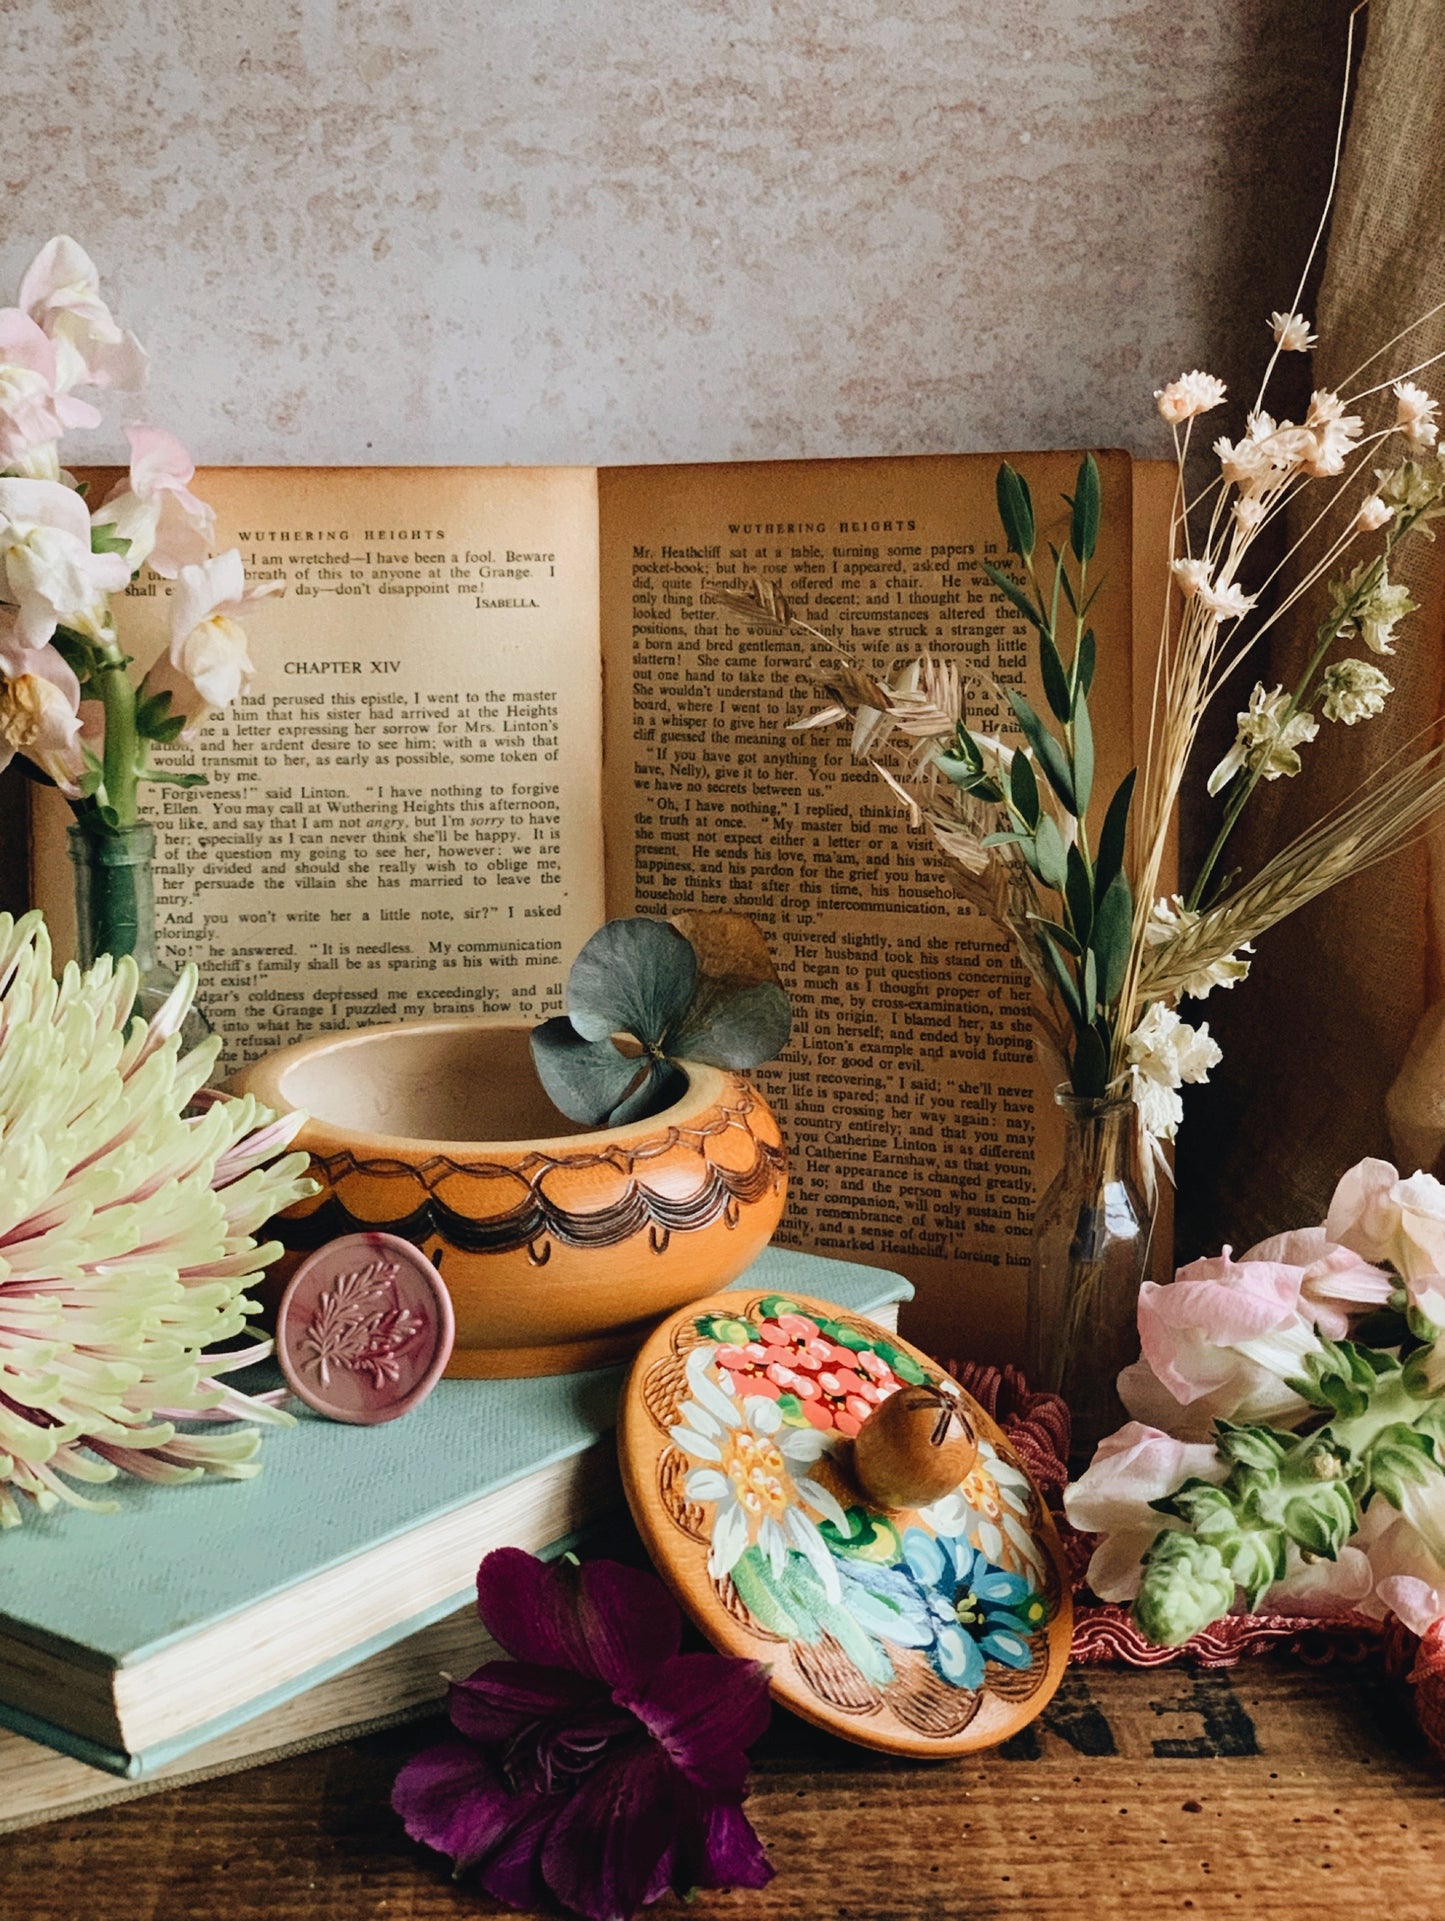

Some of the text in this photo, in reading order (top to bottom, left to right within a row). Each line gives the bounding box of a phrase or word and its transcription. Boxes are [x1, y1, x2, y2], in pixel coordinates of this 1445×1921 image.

[238, 529, 445, 541] WUTHERING HEIGHTS
[727, 519, 916, 534] WUTHERING HEIGHTS
[262, 555, 284, 564] am
[376, 550, 410, 563] have
[414, 550, 447, 563] been
[465, 549, 496, 562] fool.
[506, 549, 556, 562] Beware
[661, 545, 721, 558] Heathcliff
[729, 546, 747, 557] sat
[754, 546, 768, 557] at
[832, 544, 880, 559] turning
[887, 546, 922, 555] some
[930, 545, 975, 558] papers
[984, 542, 998, 554] in
[243, 566, 287, 579] breath
[293, 566, 310, 579] of
[317, 566, 343, 579] this
[349, 568, 364, 579] to
[371, 569, 421, 582] anyone
[427, 567, 441, 578] at
[449, 565, 471, 578] the
[477, 565, 534, 581] Grange.
[378, 581, 450, 597] disappoint
[457, 580, 484, 593] me!
[645, 637, 674, 650] born
[677, 637, 702, 650] and
[706, 638, 734, 651] bred
[928, 638, 1028, 655] thorough little
[283, 657, 401, 674] CHAPTER XIV
[240, 692, 266, 705] had
[272, 691, 325, 708] perused
[330, 691, 356, 704] this
[360, 690, 408, 707] epistle,
[426, 691, 459, 703] went
[465, 691, 480, 702] to
[484, 689, 506, 702] the
[511, 690, 557, 701] master
[232, 703, 559, 721] him that his sister had arrived at the Heights
[153, 749, 558, 767] would transmit to her, as early as possible, some token of
[714, 765, 740, 780] give
[743, 766, 753, 778] it
[757, 768, 770, 779] to
[809, 768, 837, 781] You
[634, 780, 651, 789] we
[654, 777, 683, 791] have
[686, 782, 703, 791] no
[707, 782, 748, 793] secrets
[752, 781, 803, 796] between
[163, 798, 560, 817] Ellen. You may call at Wuthering Heights this afternoon,
[634, 811, 654, 824] the
[659, 813, 690, 825] truth
[695, 815, 708, 826] at
[634, 886, 695, 902] household
[700, 890, 728, 903] here
[733, 892, 774, 906] should
[780, 894, 811, 911] drop
[956, 907, 972, 916] as
[782, 929, 837, 944] quivered
[897, 935, 922, 947] and
[927, 936, 950, 949] she
[955, 939, 1010, 952] returned
[257, 953, 562, 974] family shall be as sparing as his with mine.
[802, 960, 1032, 988] began to put questions concerning
[247, 983, 563, 1004] coldness depressed me exceedingly; and all
[793, 1117, 842, 1132] country
[908, 1123, 934, 1136] and
[940, 1124, 967, 1139] that
[973, 1131, 999, 1144] you
[1005, 1133, 1035, 1148] may
[793, 1130, 1035, 1160] you Catherine Linton is as different
[806, 1158, 831, 1173] Her
[834, 1165, 909, 1180] appearance
[913, 1168, 924, 1181] is
[927, 1170, 982, 1188] changed
[813, 1237, 875, 1251] remarked
[953, 1246, 1001, 1267] forcing
[1005, 1252, 1031, 1267] him
